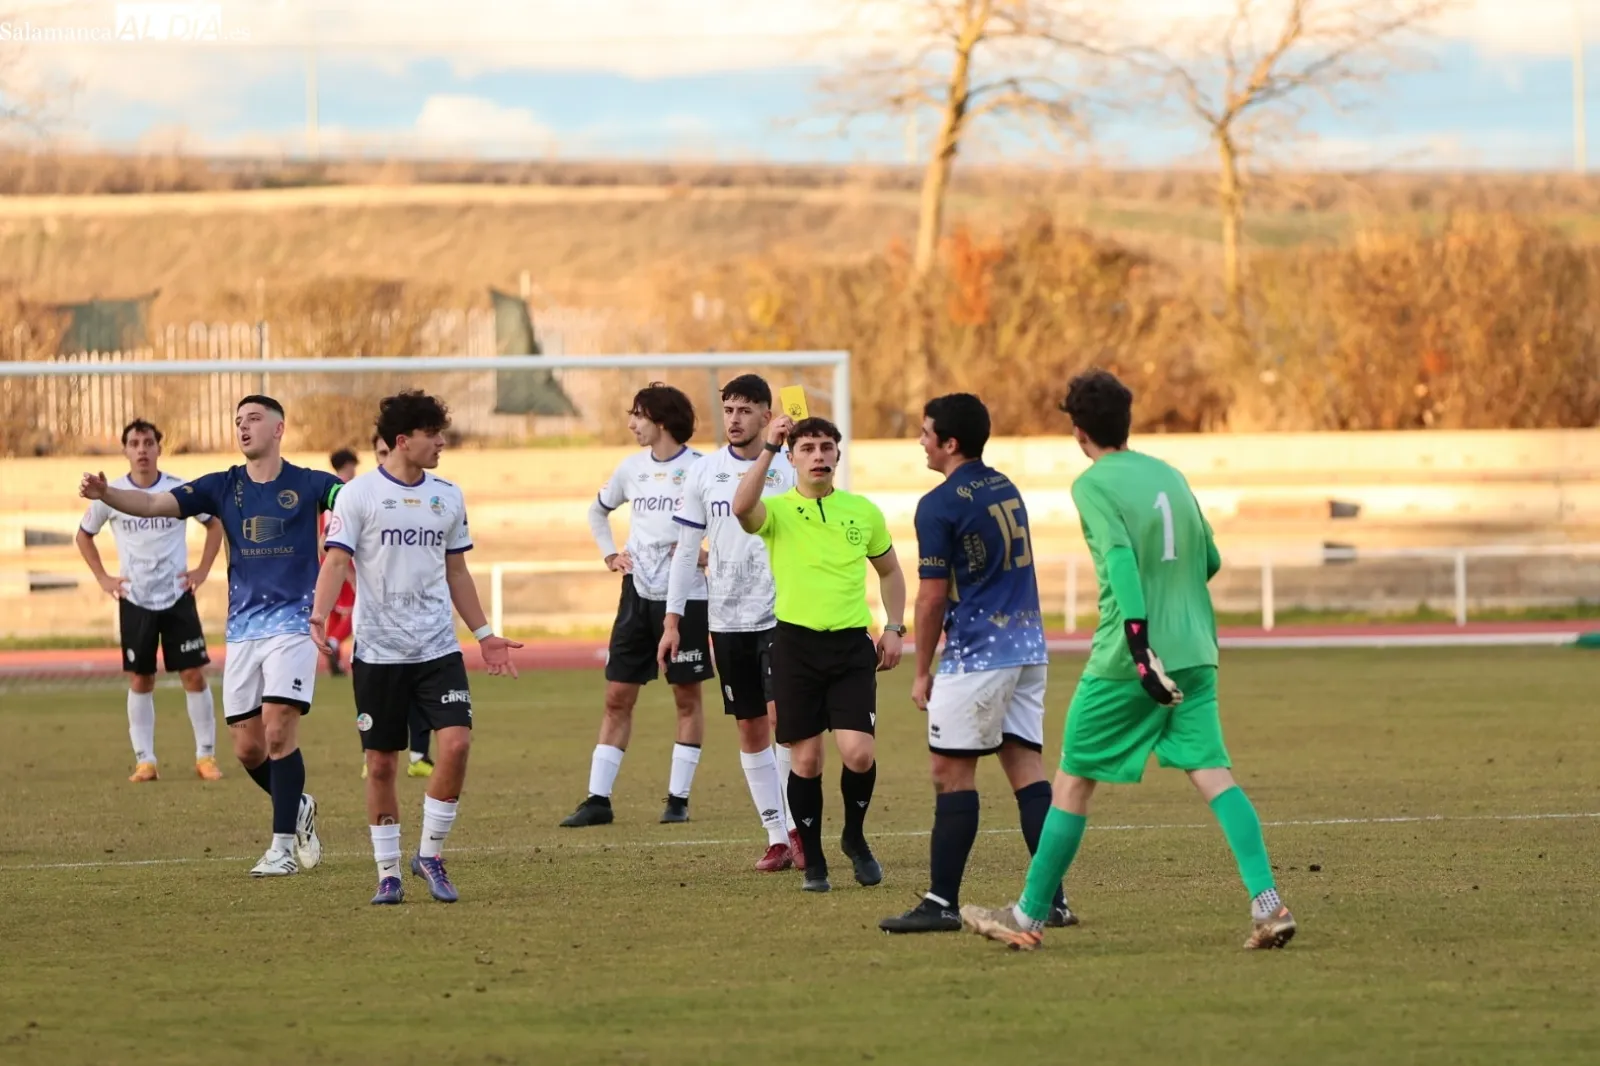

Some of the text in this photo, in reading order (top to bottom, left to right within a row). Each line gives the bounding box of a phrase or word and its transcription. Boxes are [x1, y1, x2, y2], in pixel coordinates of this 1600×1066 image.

[381, 527, 444, 546] meins
[988, 498, 1031, 571] 15
[1153, 491, 1178, 562] 1
